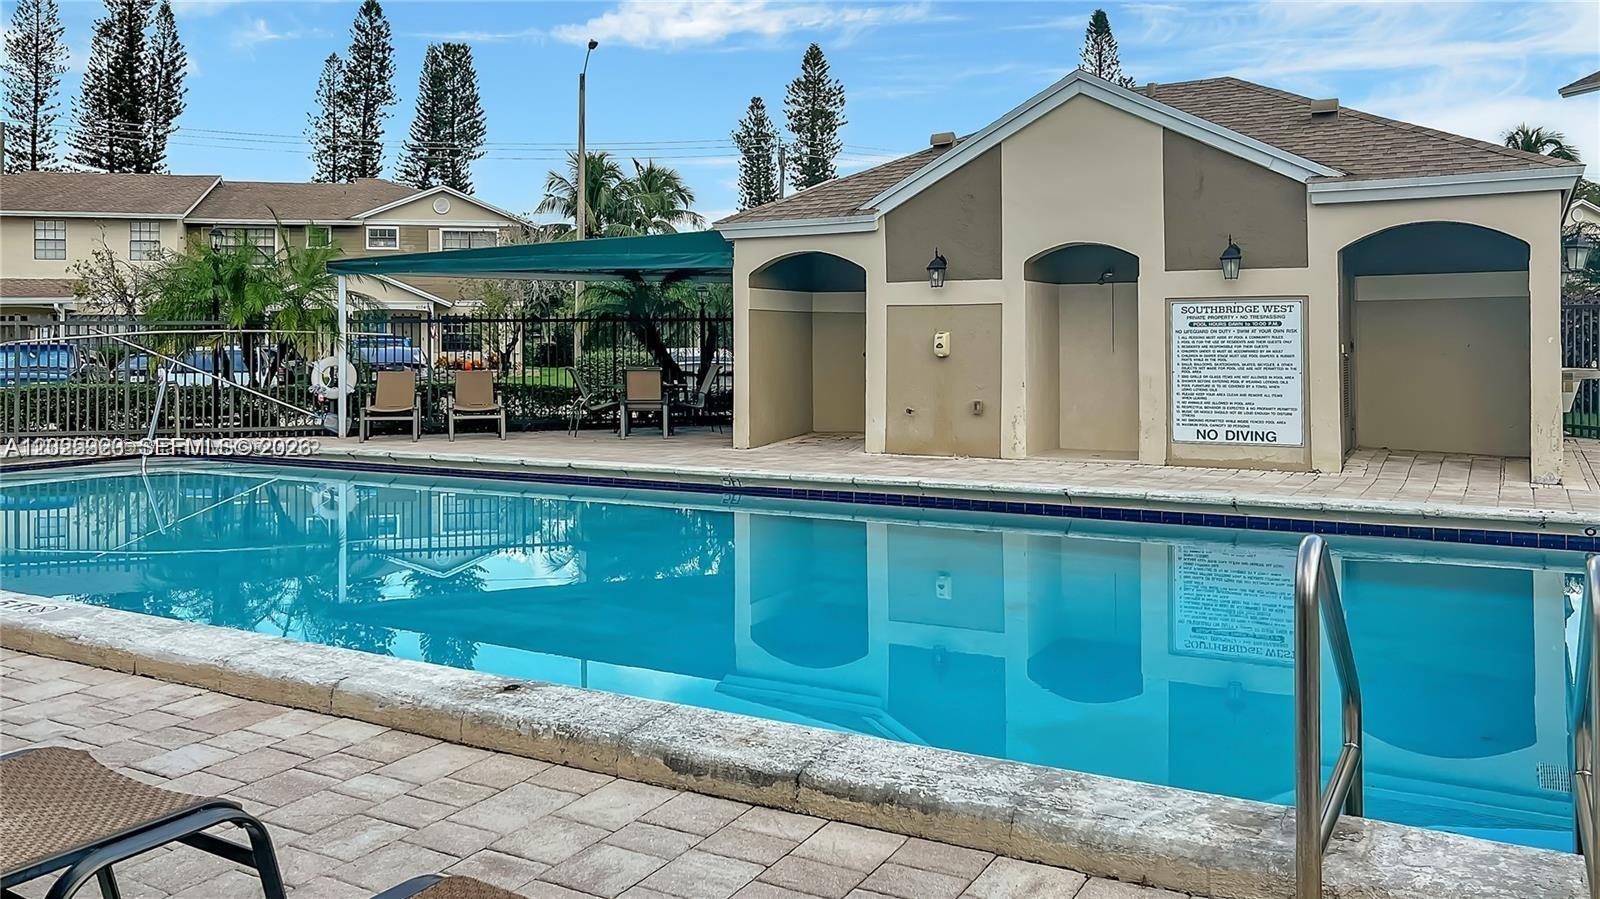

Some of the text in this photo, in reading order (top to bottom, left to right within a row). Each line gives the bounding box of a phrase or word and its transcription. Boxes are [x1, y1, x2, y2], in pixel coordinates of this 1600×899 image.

[1181, 305, 1294, 314] SOUTHBRIDGE WEST
[1196, 429, 1277, 442] NO DIVING
